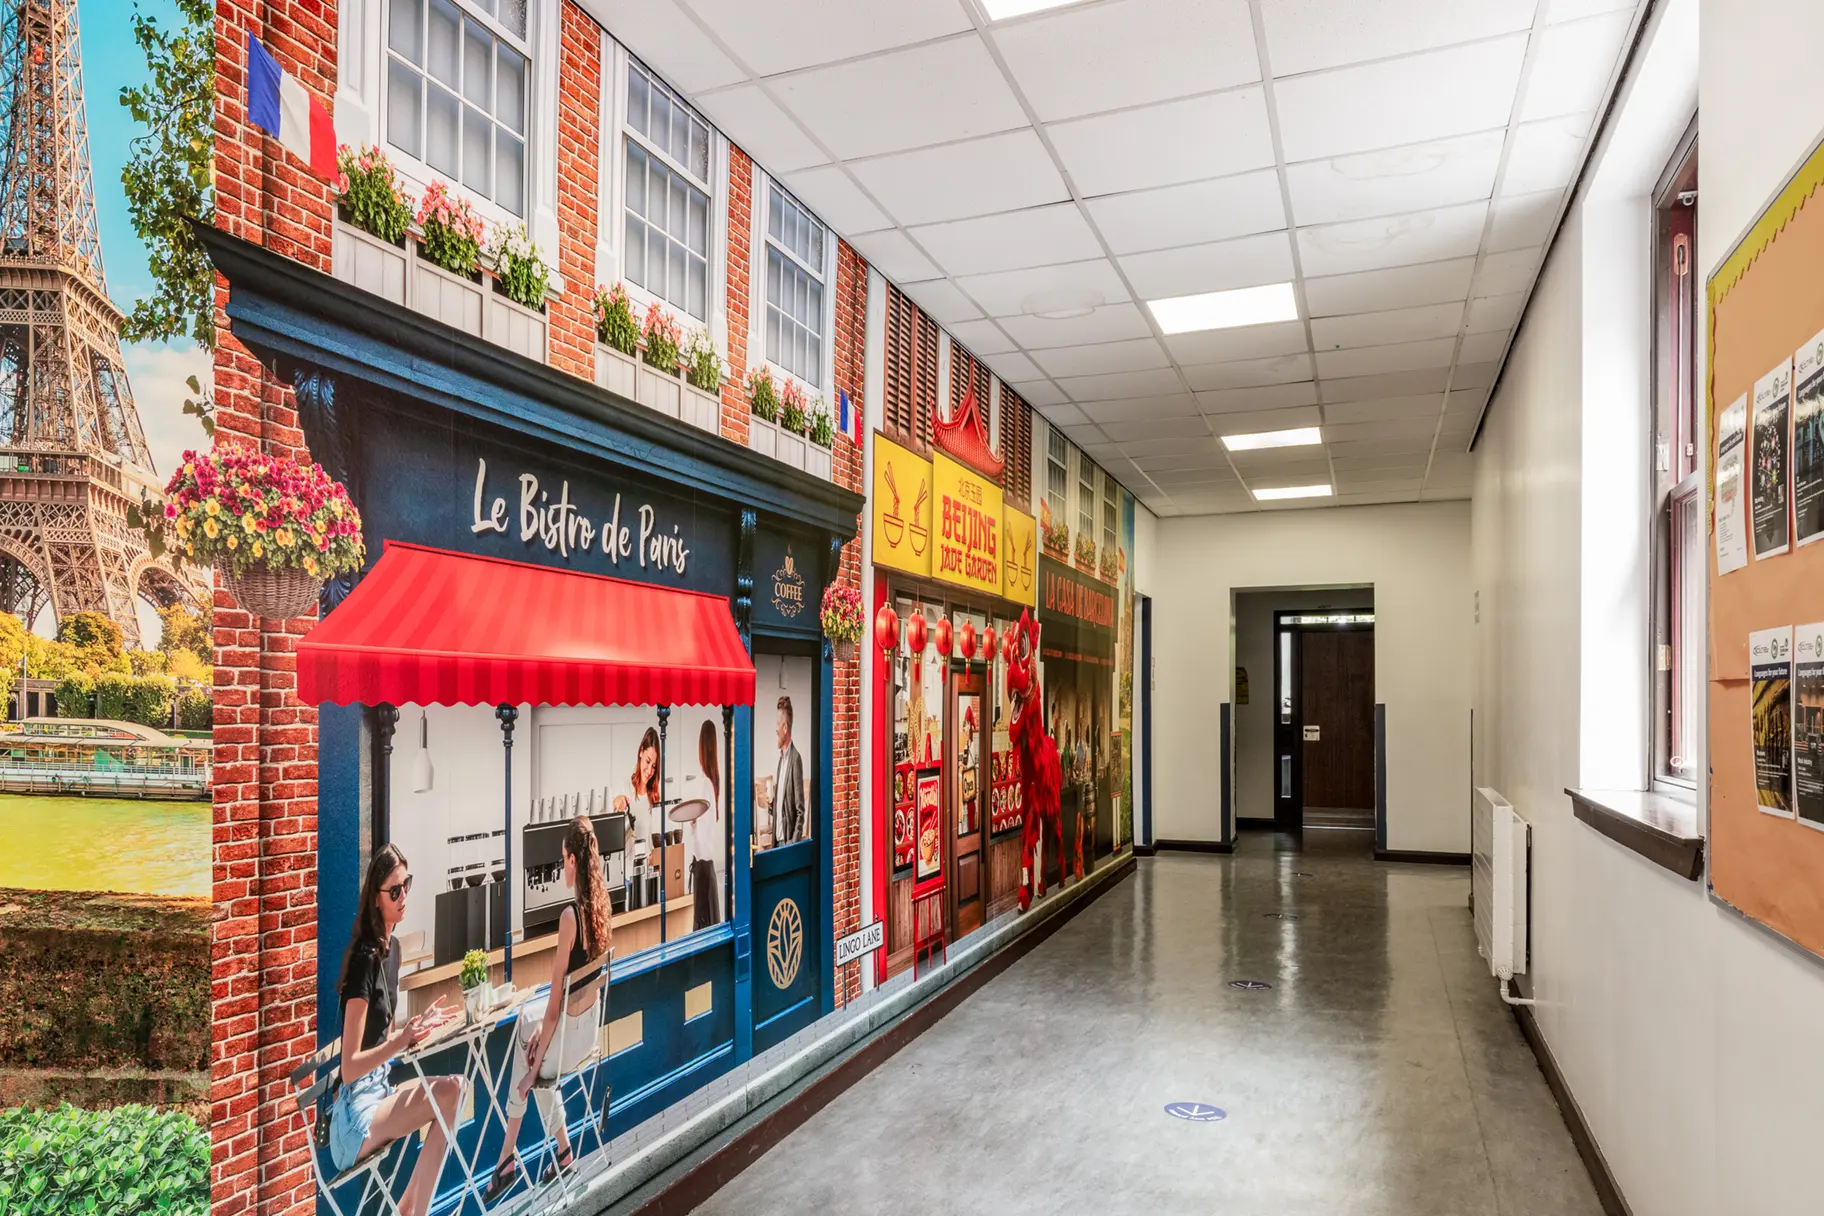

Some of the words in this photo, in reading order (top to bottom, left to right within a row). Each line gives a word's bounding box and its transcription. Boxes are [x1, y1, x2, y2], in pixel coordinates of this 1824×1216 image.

[471, 457, 509, 533] Le
[519, 473, 595, 558] Bistro
[602, 493, 632, 564] de
[638, 504, 690, 574] Paris
[942, 494, 996, 559] BEIJING
[940, 544, 962, 574] JADE
[965, 552, 997, 584] GARDEN
[775, 582, 802, 601] COFFEE
[1046, 571, 1055, 610] LA
[1056, 576, 1075, 616] CASA
[839, 937, 861, 959] LINGO
[863, 928, 880, 948] LANE
